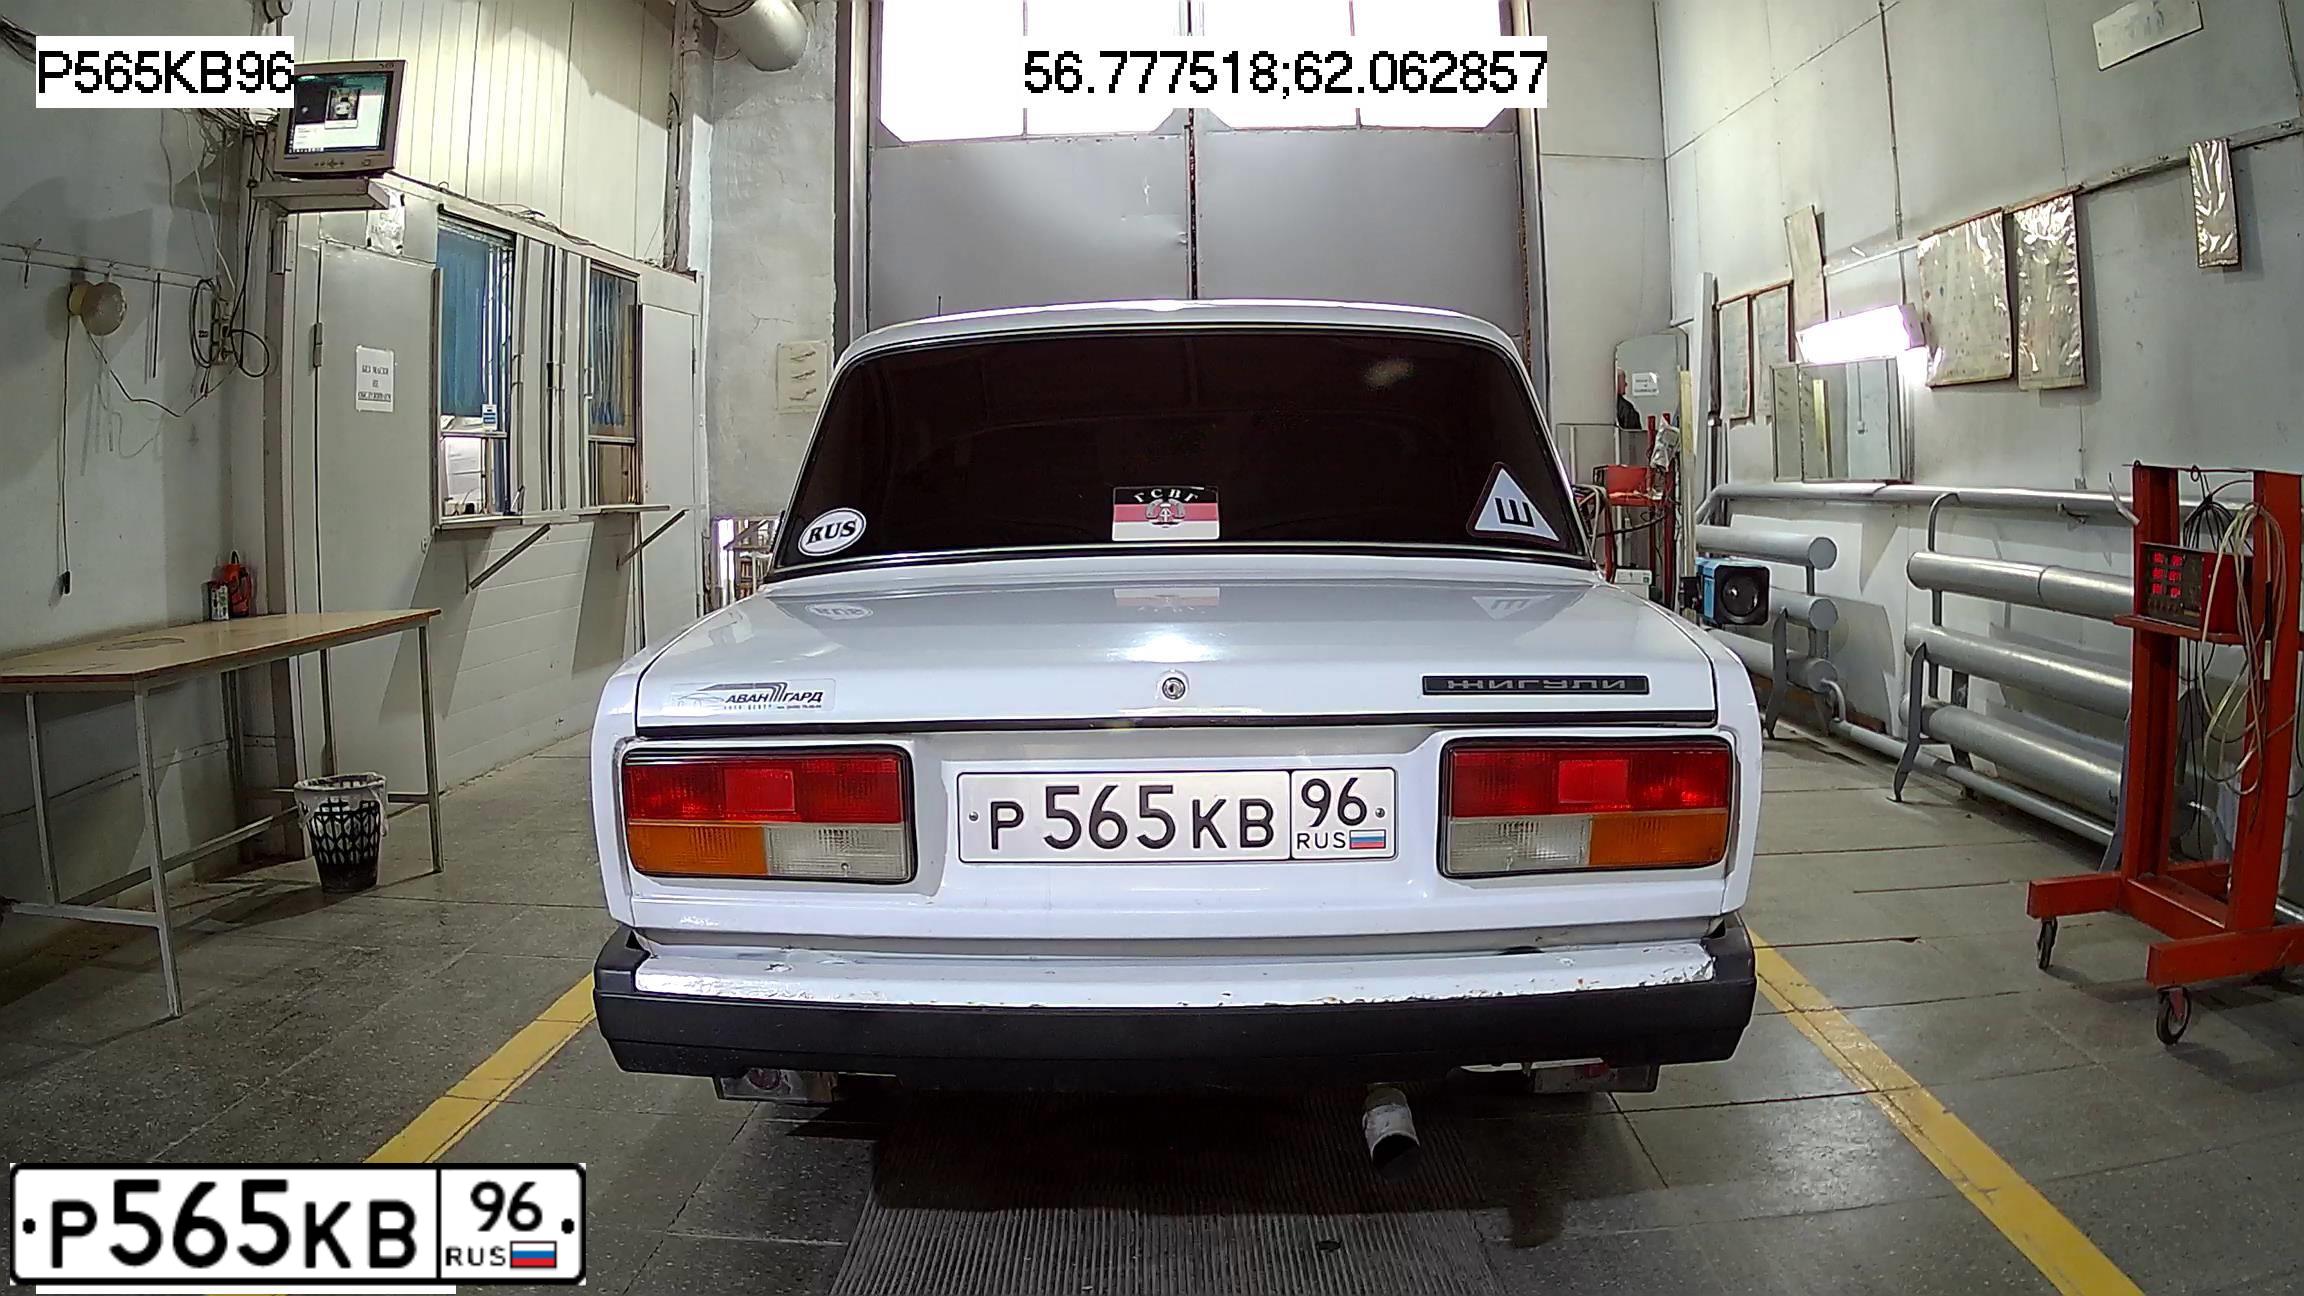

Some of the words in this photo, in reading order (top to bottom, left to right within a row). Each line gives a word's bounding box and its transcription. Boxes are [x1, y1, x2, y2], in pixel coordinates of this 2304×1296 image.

[1494, 497, 1535, 529] Ш
[805, 518, 858, 546] RUS
[1446, 679, 1627, 690] ЖИГУЛИ
[1300, 776, 1369, 828] 96
[1296, 831, 1347, 850] RUS
